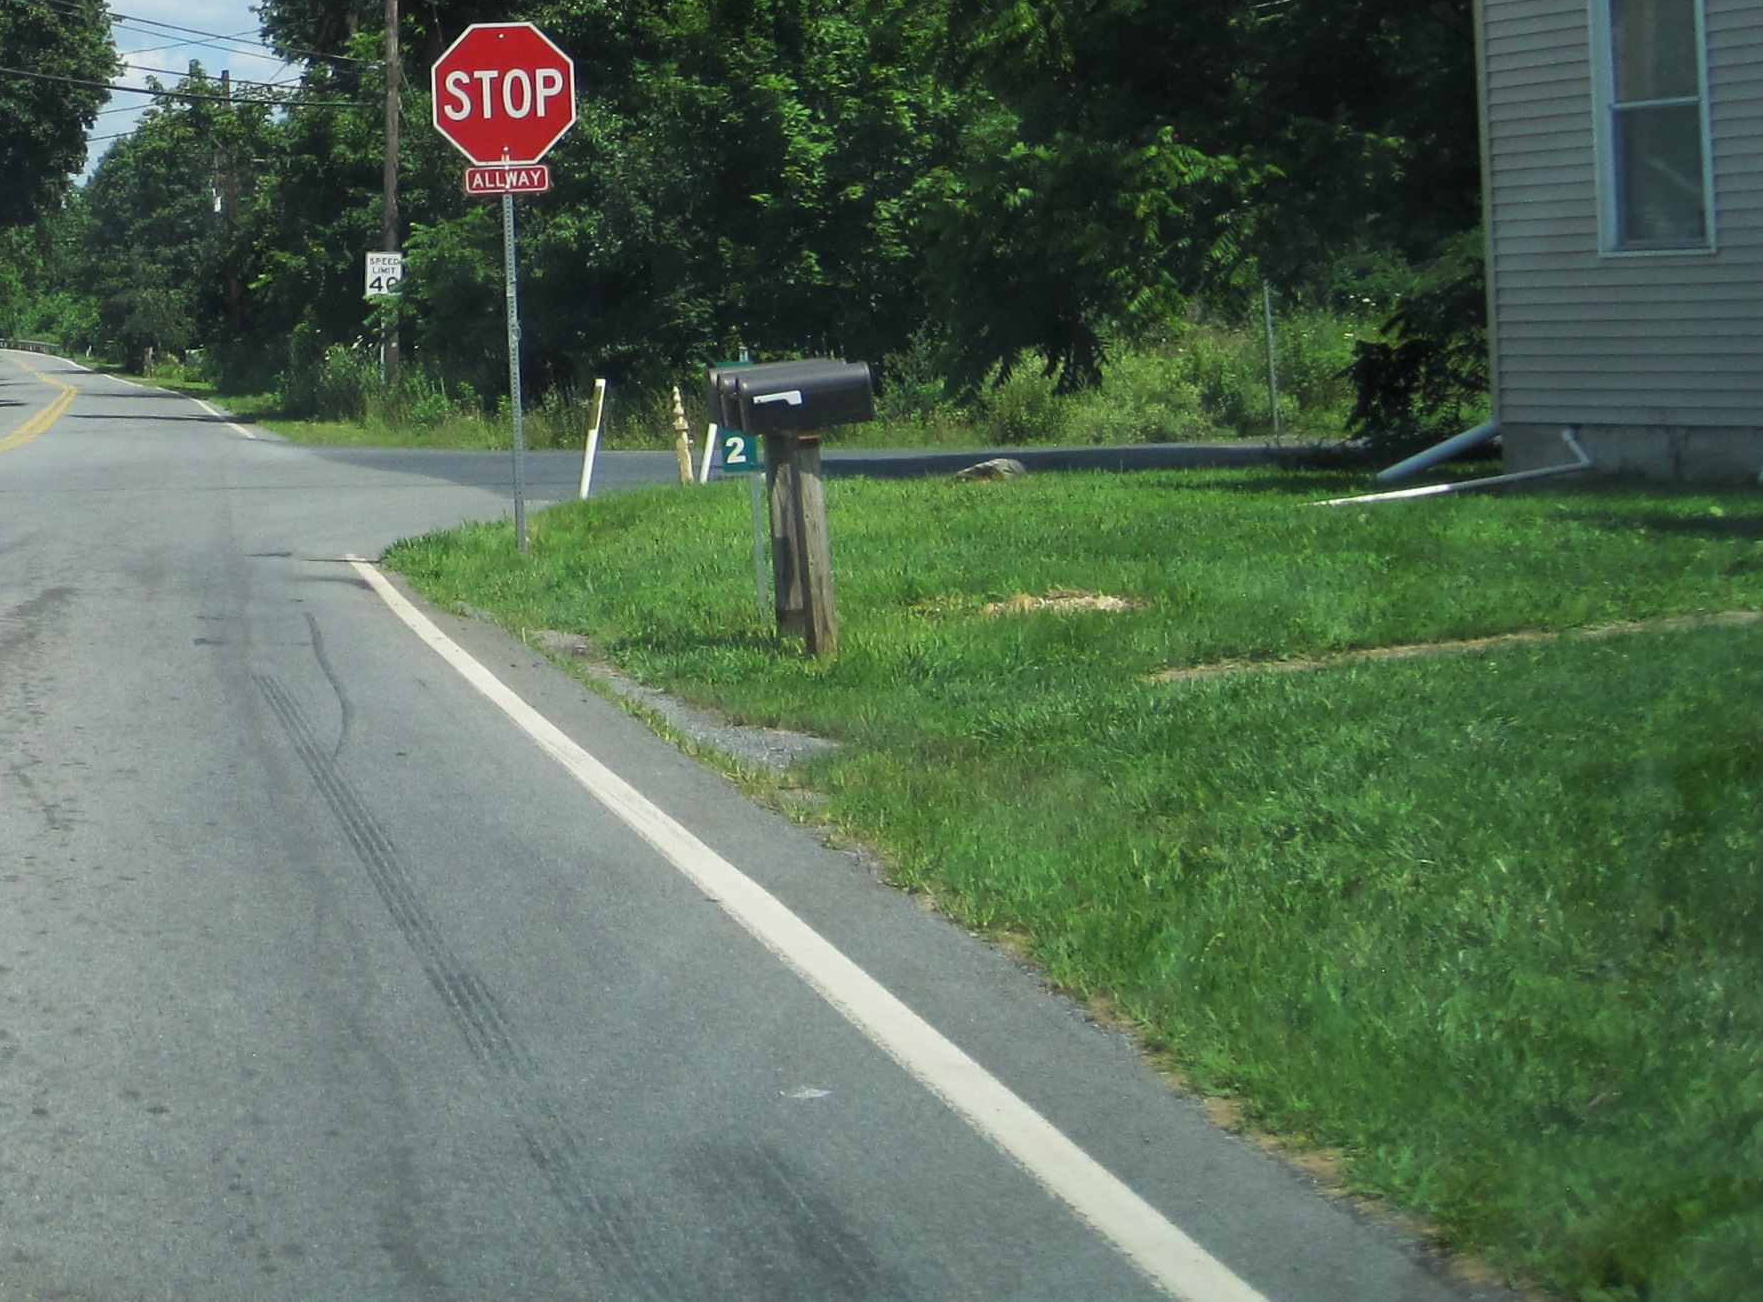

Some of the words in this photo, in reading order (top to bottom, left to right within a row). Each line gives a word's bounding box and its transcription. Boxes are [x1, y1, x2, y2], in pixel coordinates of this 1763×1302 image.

[443, 68, 564, 121] STOP
[369, 257, 400, 266] SPEED
[725, 436, 747, 465] 2
